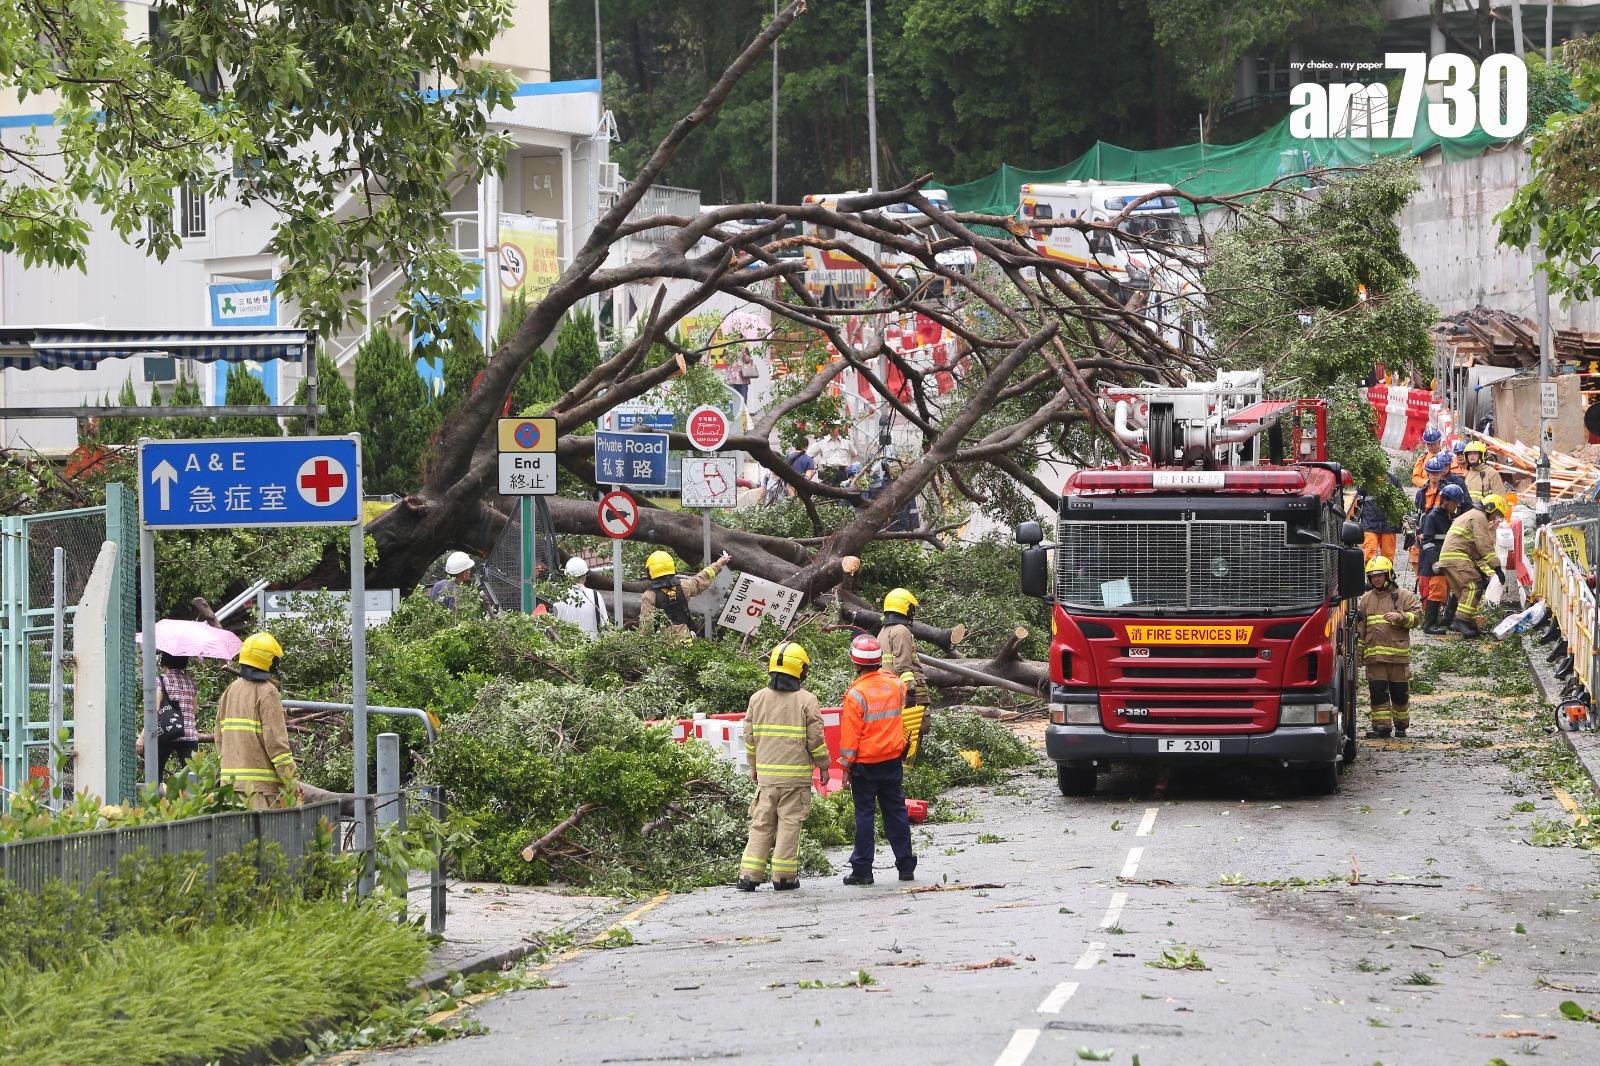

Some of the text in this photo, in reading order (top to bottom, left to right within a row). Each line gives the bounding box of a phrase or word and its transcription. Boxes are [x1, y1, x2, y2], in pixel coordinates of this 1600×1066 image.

[597, 437, 663, 454] Private Road
[185, 452, 246, 472] A & E
[514, 457, 541, 469] End
[602, 457, 653, 479] 私家路
[509, 473, 545, 490] 終止
[1172, 475, 1204, 484] FIRE
[188, 483, 288, 513] 急症室
[735, 578, 754, 602] km/h
[746, 598, 767, 617] 15
[783, 592, 798, 613] SAFE
[1131, 628, 1247, 641] 消 FIRE SERVICES 防
[1166, 740, 1213, 751] F 2301
